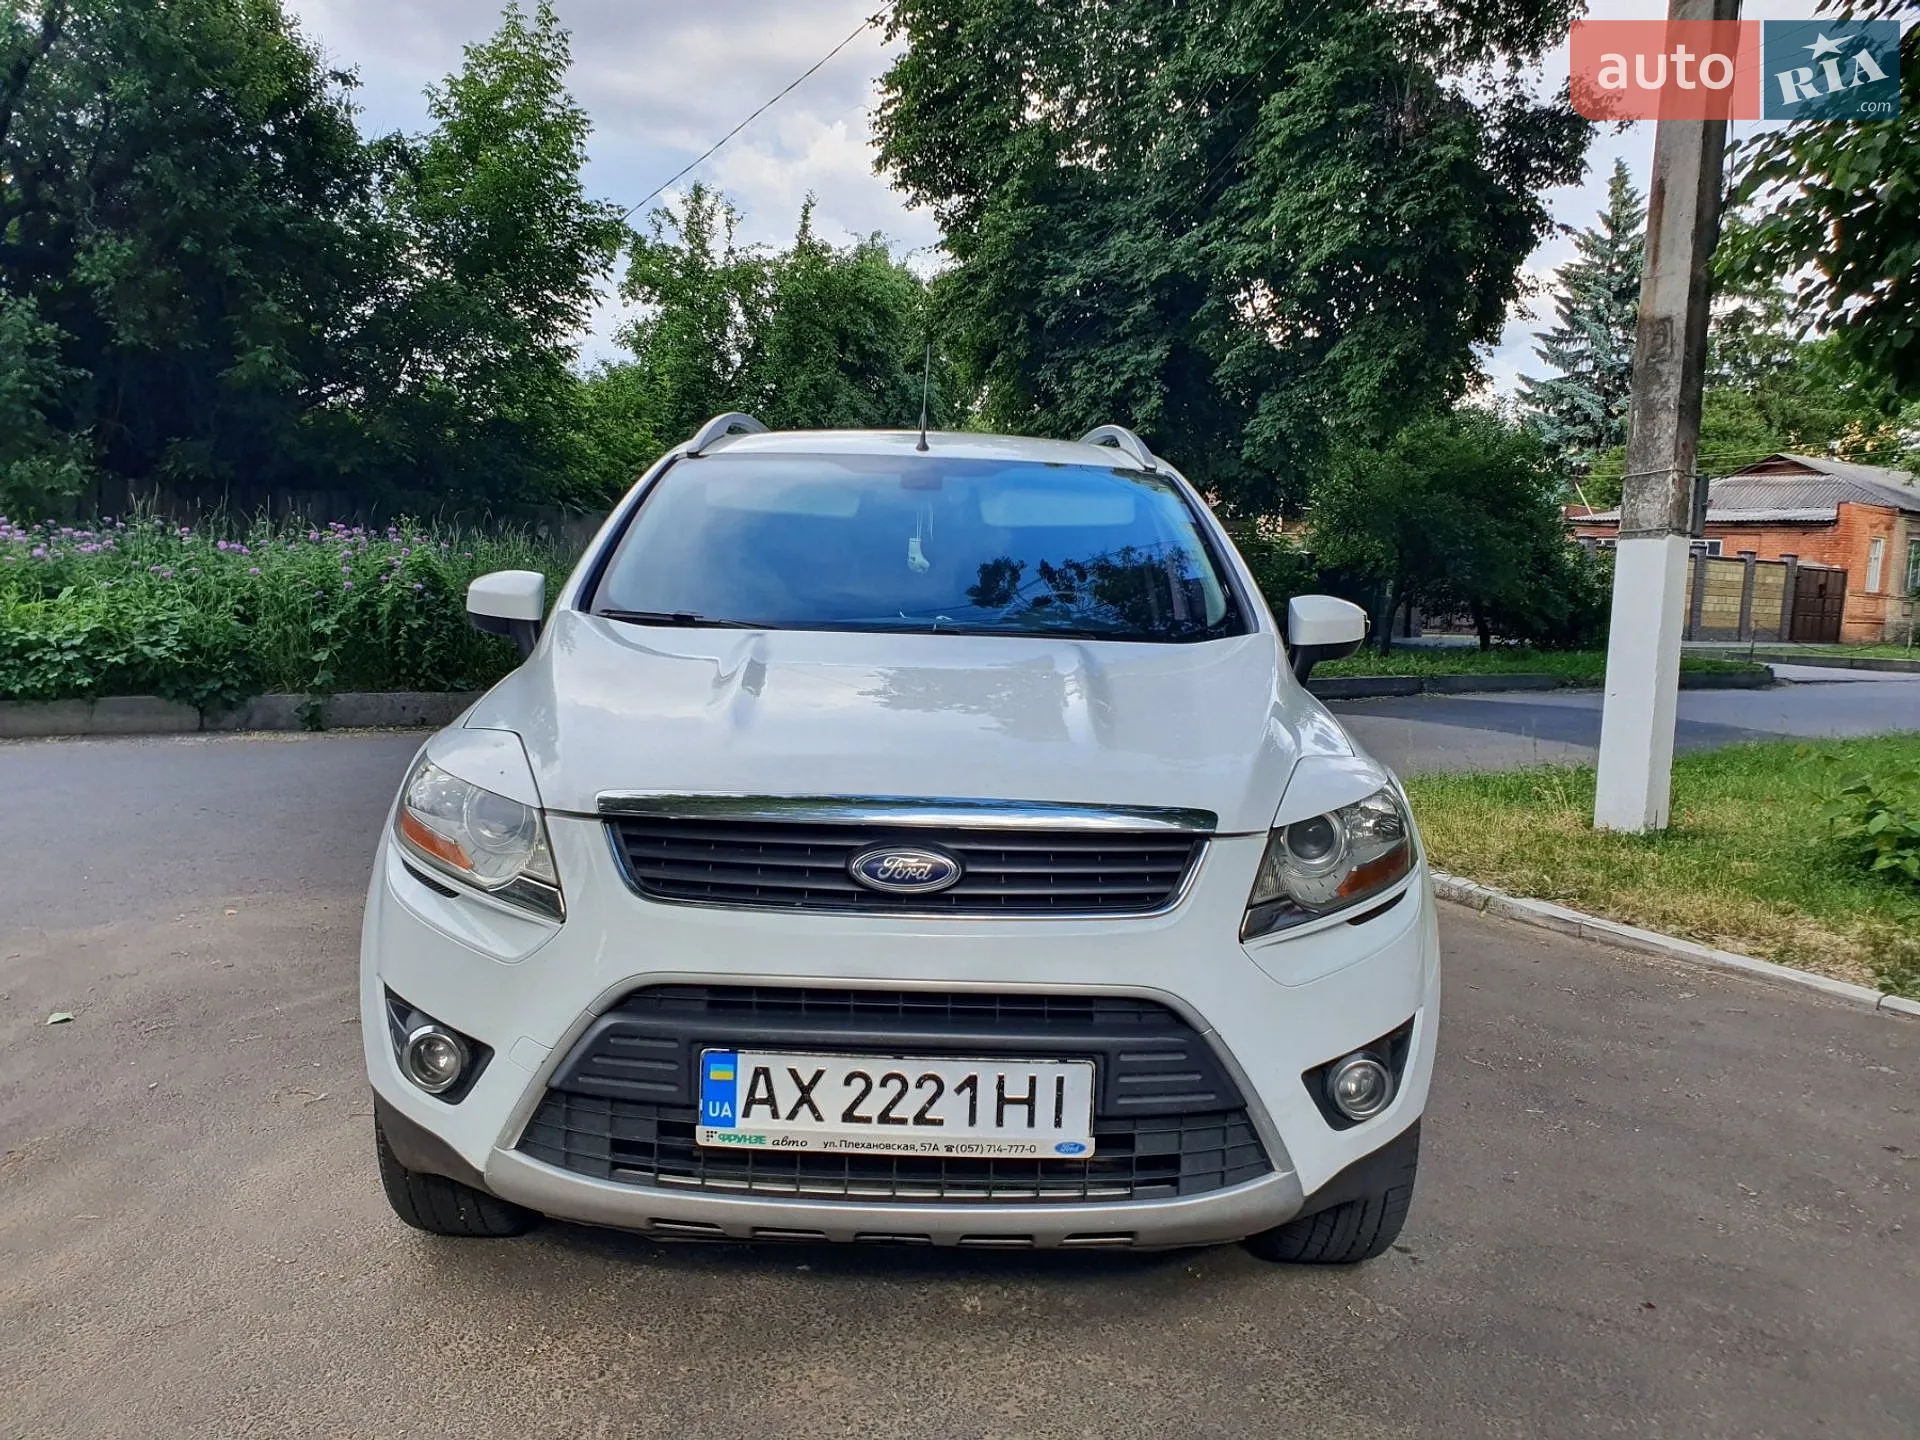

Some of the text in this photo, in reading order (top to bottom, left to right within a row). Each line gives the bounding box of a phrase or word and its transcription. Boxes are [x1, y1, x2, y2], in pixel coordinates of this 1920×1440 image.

[877, 856, 933, 880] Ford
[708, 1102, 733, 1119] UA
[986, 1144, 1037, 1154] 714-777-0
